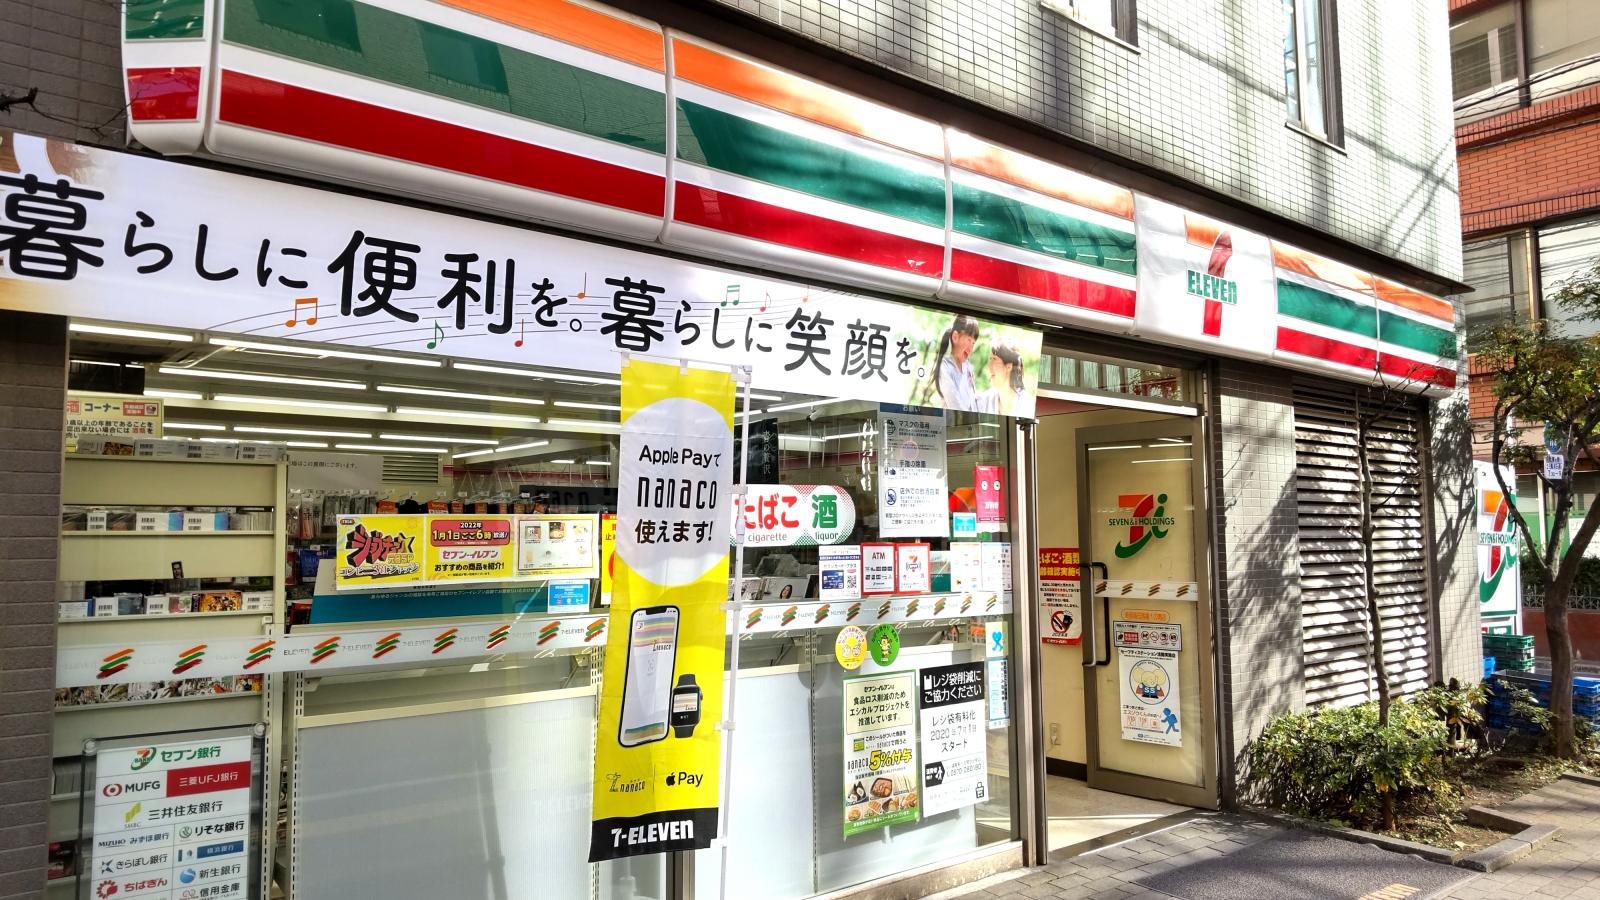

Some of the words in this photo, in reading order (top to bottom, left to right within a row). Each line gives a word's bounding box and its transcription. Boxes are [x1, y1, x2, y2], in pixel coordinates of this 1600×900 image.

[84, 402, 121, 413] コーナー
[638, 444, 679, 466] Apple
[636, 476, 717, 510] nanaco
[812, 494, 838, 529] 酒
[460, 521, 483, 529] 2022年
[1139, 517, 1175, 526] HOLDINGS
[634, 518, 713, 544] 使えます!
[748, 532, 787, 543] cigarette
[814, 531, 839, 542] liquor
[871, 551, 886, 561] ATM
[1039, 553, 1080, 565] ばこ・酒類
[933, 669, 982, 689] レジ袋削減に
[923, 684, 982, 703] ご協力ください
[849, 700, 910, 717] エシカルプロジェクトを
[932, 710, 976, 726] レジ袋有料化
[161, 745, 221, 763] セブン銀行
[941, 739, 968, 753] スタート
[125, 781, 160, 793] MUFG
[179, 772, 238, 787] 三菱UFJ銀行
[677, 771, 704, 788] Pay
[148, 801, 223, 821] 三井住友銀行
[194, 821, 245, 836] りそな銀行
[98, 838, 126, 848] MIZUHO
[129, 832, 170, 845] みずほ銀行
[115, 853, 168, 870] きらぼし銀行
[199, 864, 241, 880] 新生銀行
[123, 877, 168, 893] ちばぎん
[199, 882, 241, 898] 信用金庫
